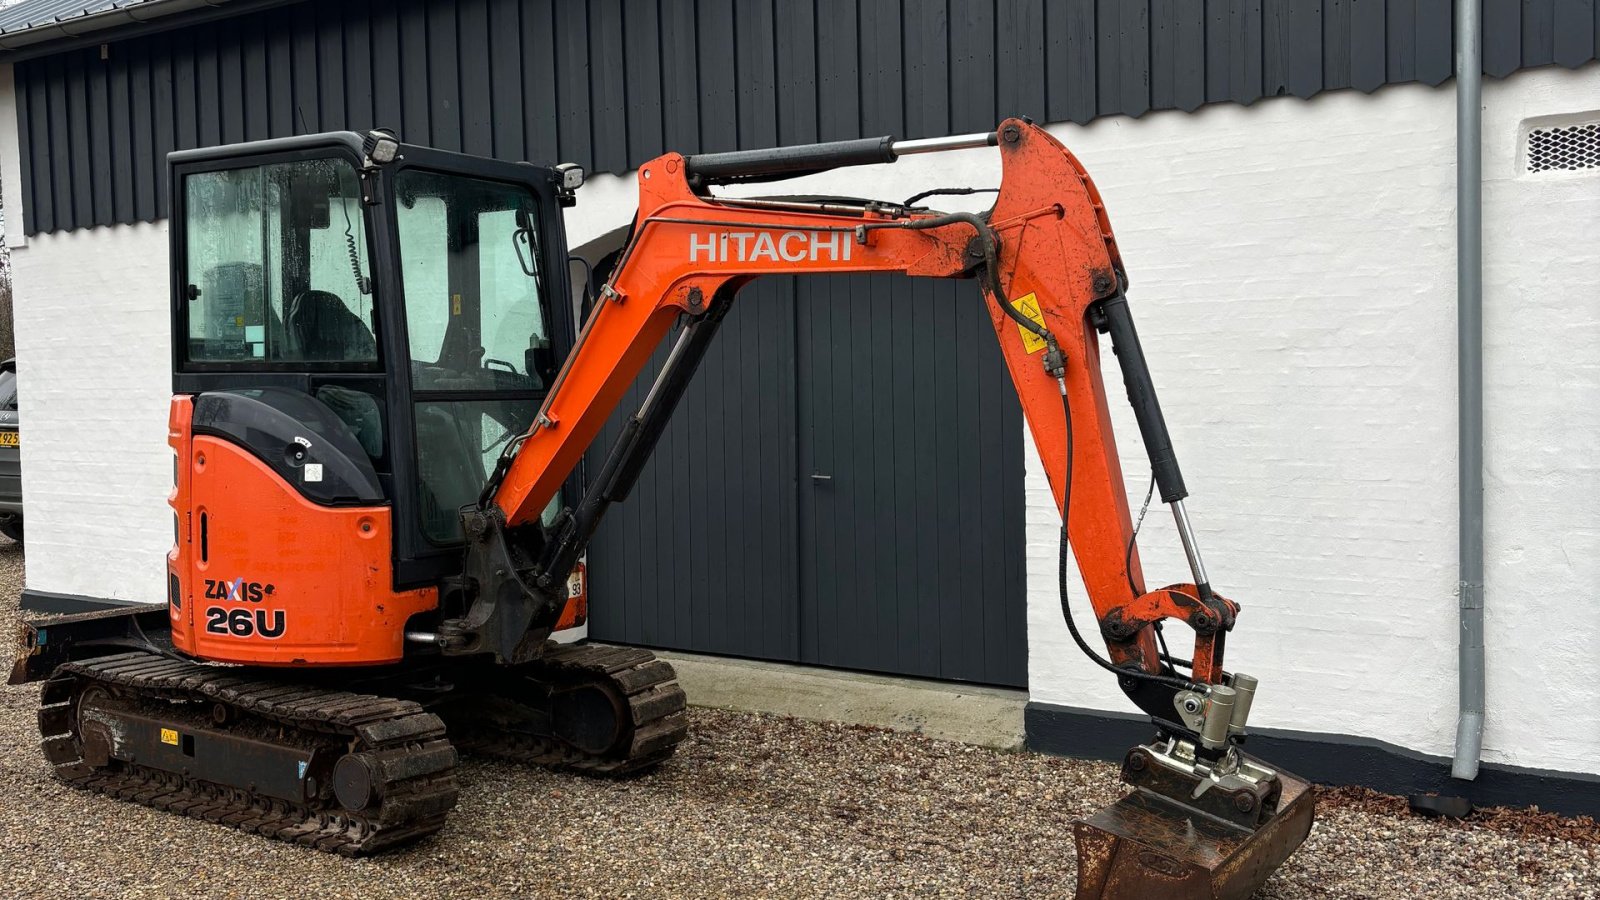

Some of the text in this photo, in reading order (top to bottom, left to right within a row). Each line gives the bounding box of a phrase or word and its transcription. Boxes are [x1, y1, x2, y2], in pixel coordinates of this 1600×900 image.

[690, 231, 852, 262] HITACHI
[3, 433, 12, 444] 92
[205, 577, 263, 603] ZAXIS
[572, 582, 581, 595] 93
[206, 605, 287, 640] 26U
